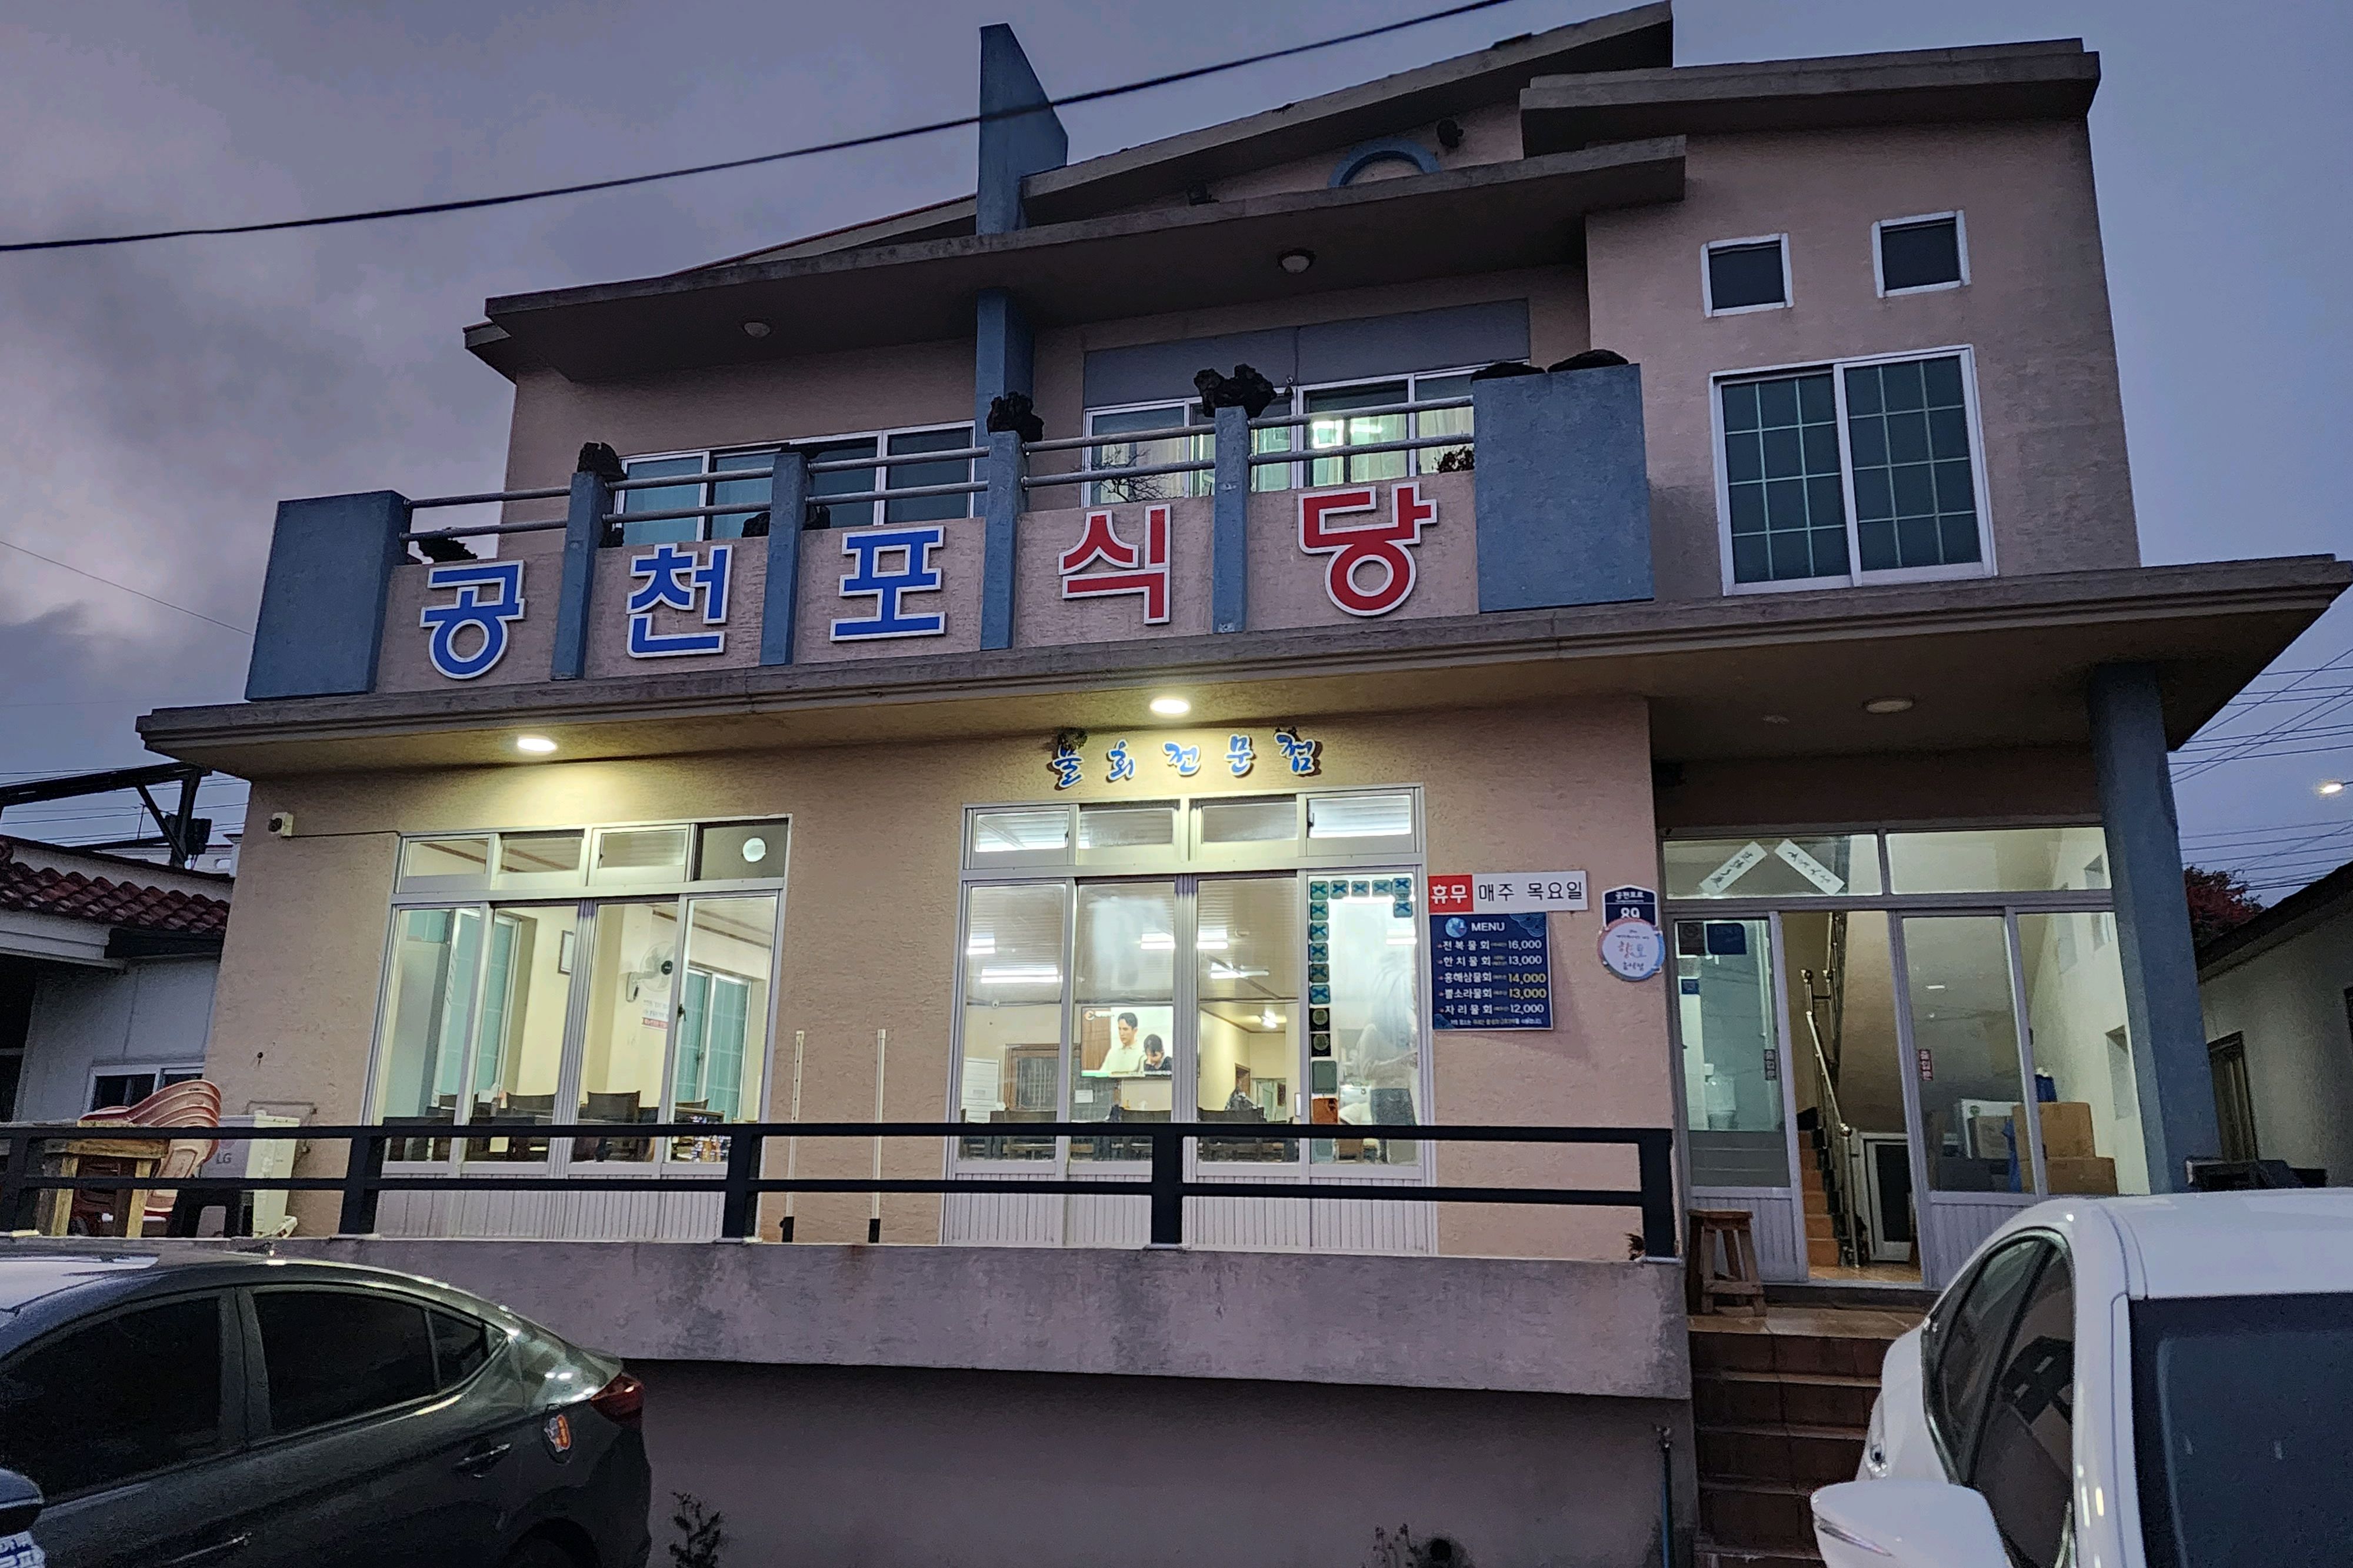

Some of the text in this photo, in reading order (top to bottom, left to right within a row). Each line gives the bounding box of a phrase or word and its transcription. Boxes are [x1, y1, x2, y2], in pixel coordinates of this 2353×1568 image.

[1431, 881, 1583, 905] 휴무 매주 목요일
[1621, 907, 1640, 919] 89
[1471, 922, 1505, 932] MENU
[1508, 940, 1542, 951] 16,000
[1508, 955, 1542, 966] 13,000
[1508, 973, 1547, 985] 14,000
[1509, 988, 1547, 1000] 13,000
[1510, 1003, 1545, 1015] 12,000
[216, 1153, 232, 1165] LG
